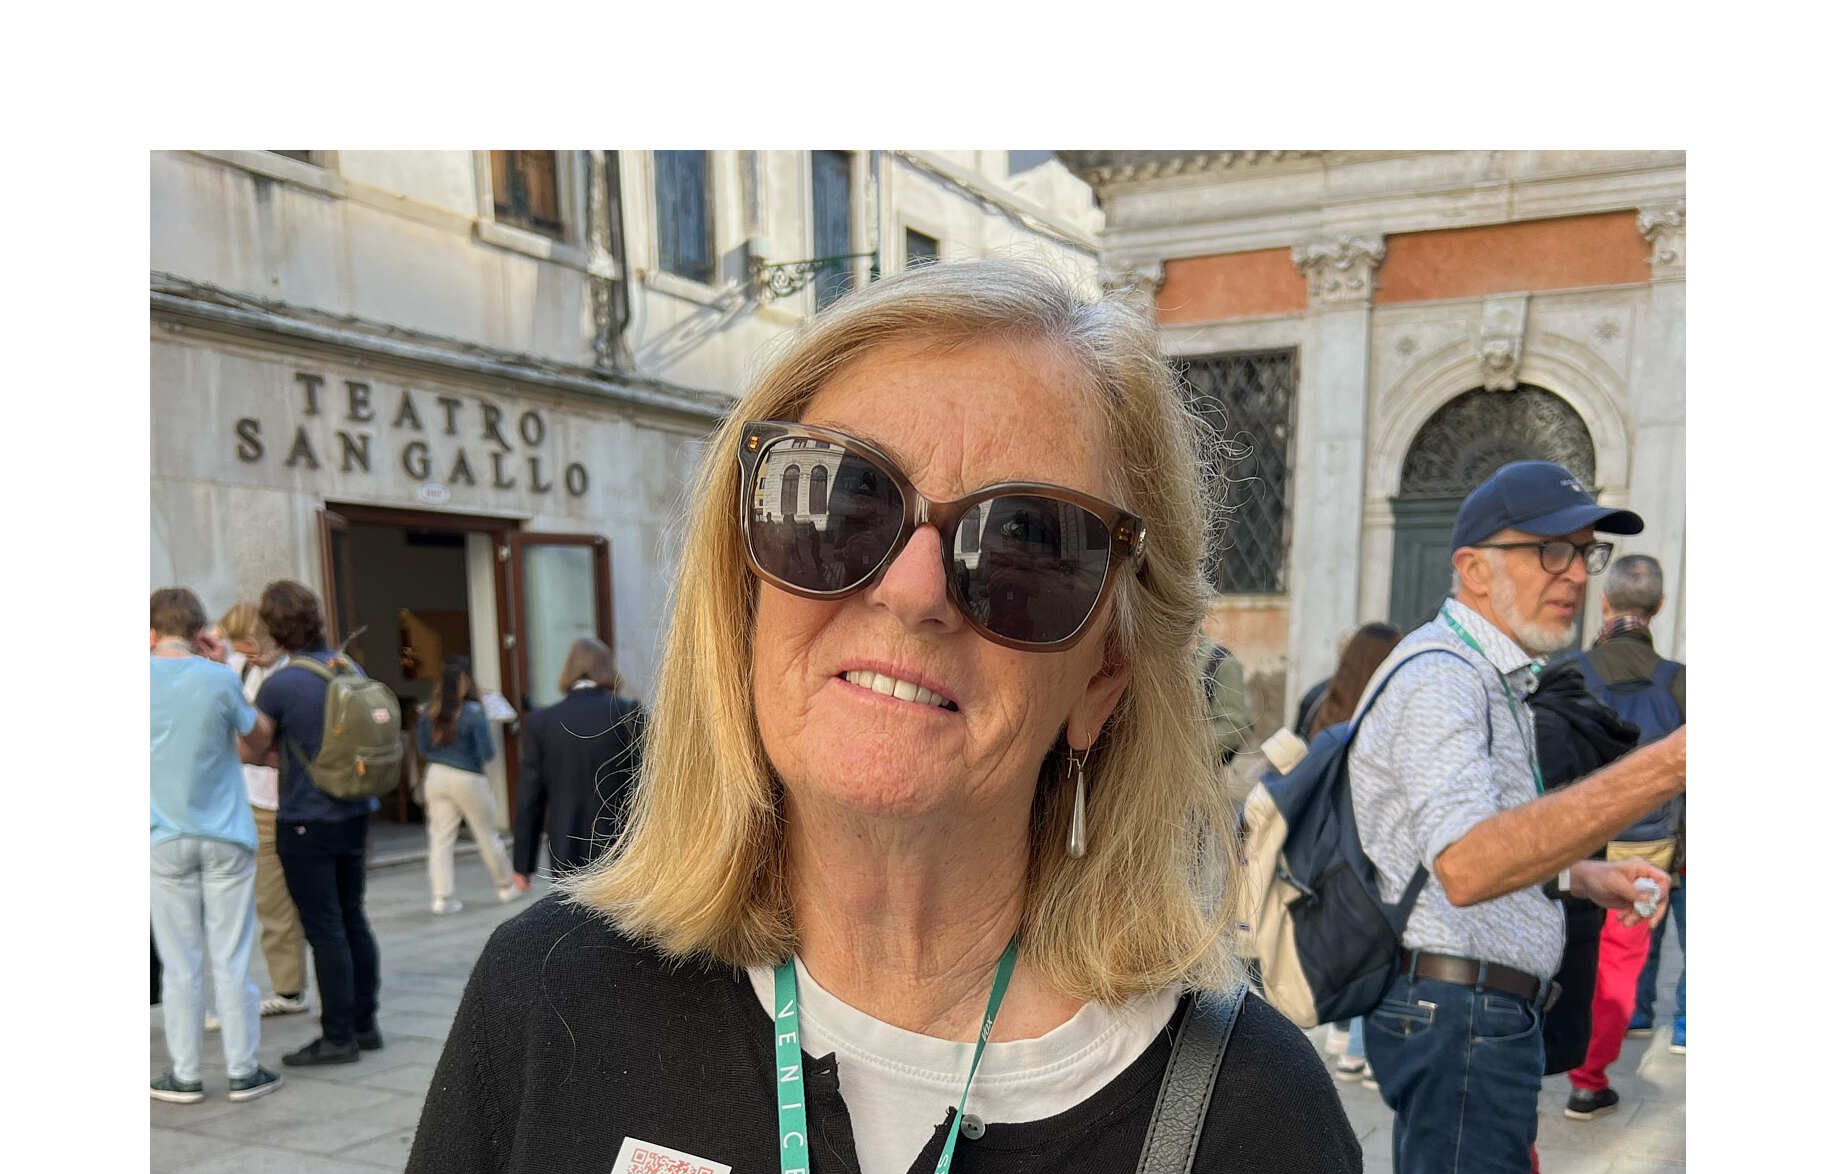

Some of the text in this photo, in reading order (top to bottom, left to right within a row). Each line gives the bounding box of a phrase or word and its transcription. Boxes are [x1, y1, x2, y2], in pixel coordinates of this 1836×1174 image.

[295, 372, 546, 451] TEATRO
[235, 417, 590, 497] SAN GALLO
